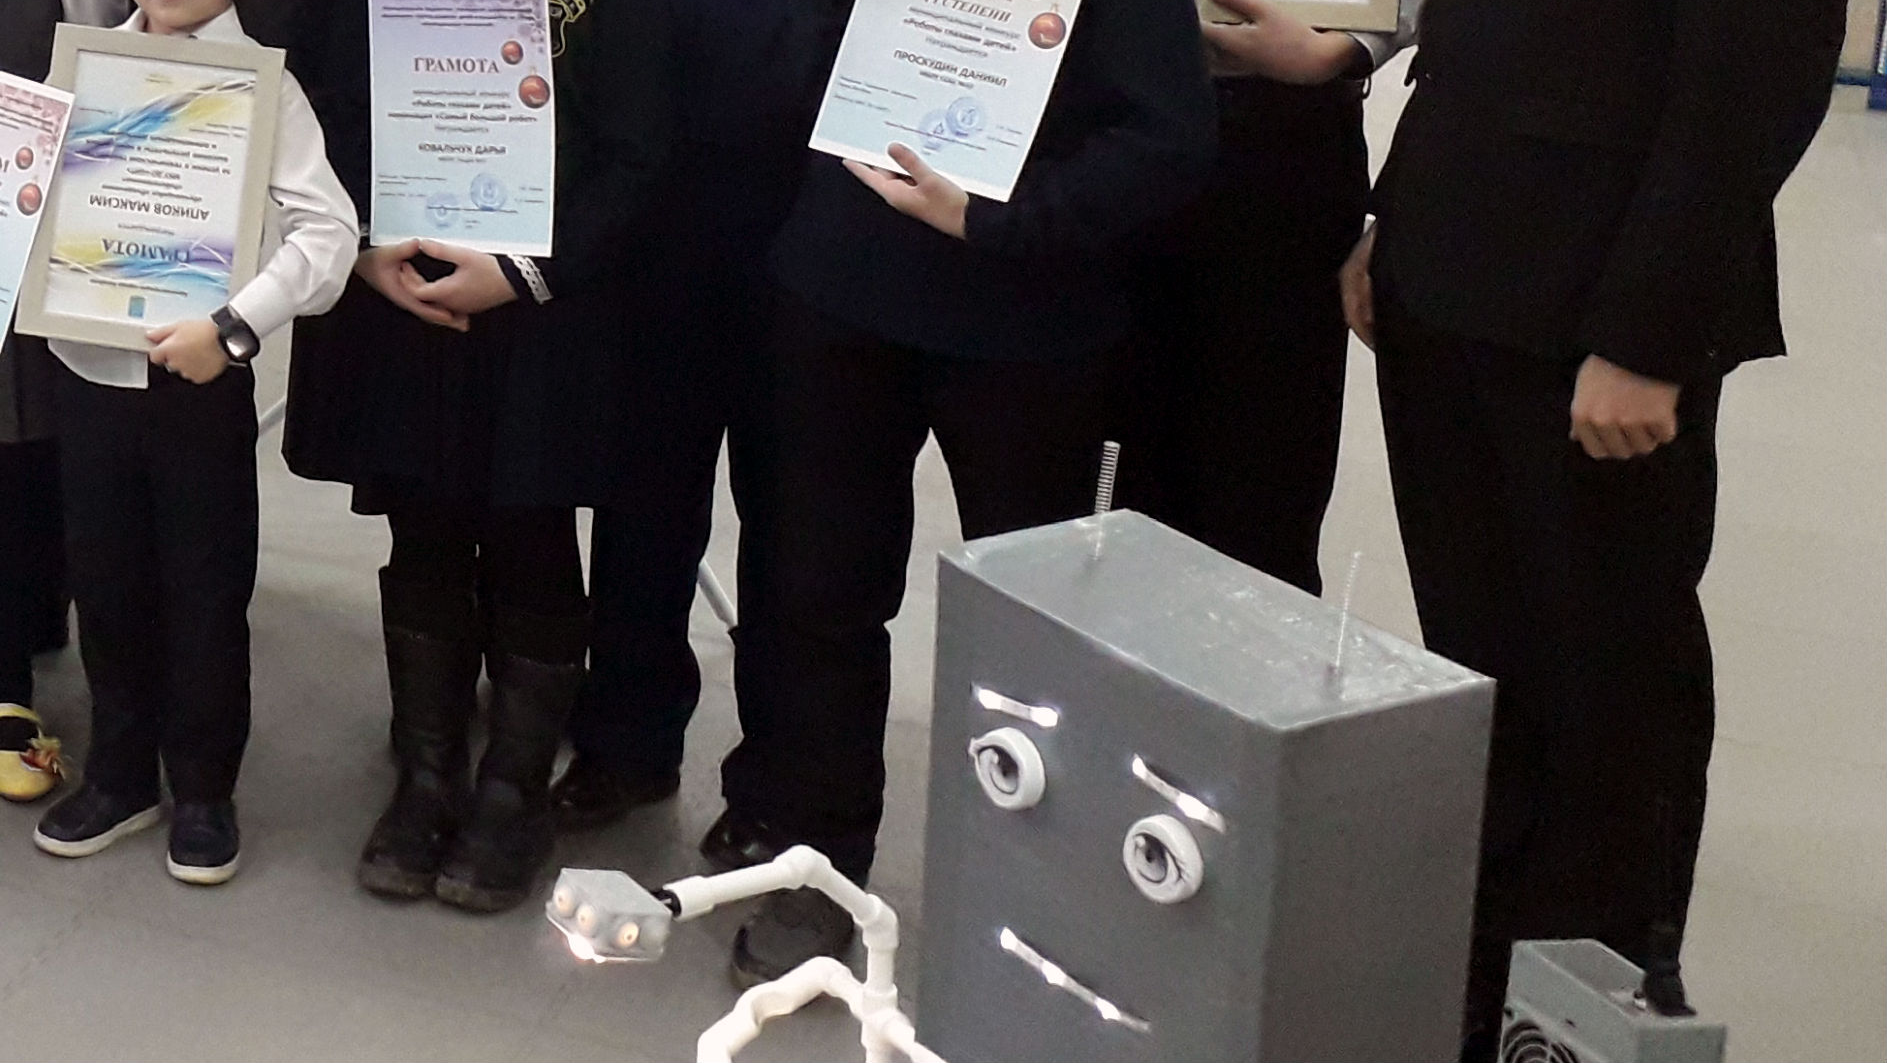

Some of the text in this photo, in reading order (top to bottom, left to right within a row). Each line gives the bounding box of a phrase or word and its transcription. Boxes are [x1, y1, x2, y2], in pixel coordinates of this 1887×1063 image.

[413, 57, 500, 75] ГРАМОТА
[89, 193, 150, 214] МАКСИМ
[102, 238, 191, 264] ГРАМОТА
